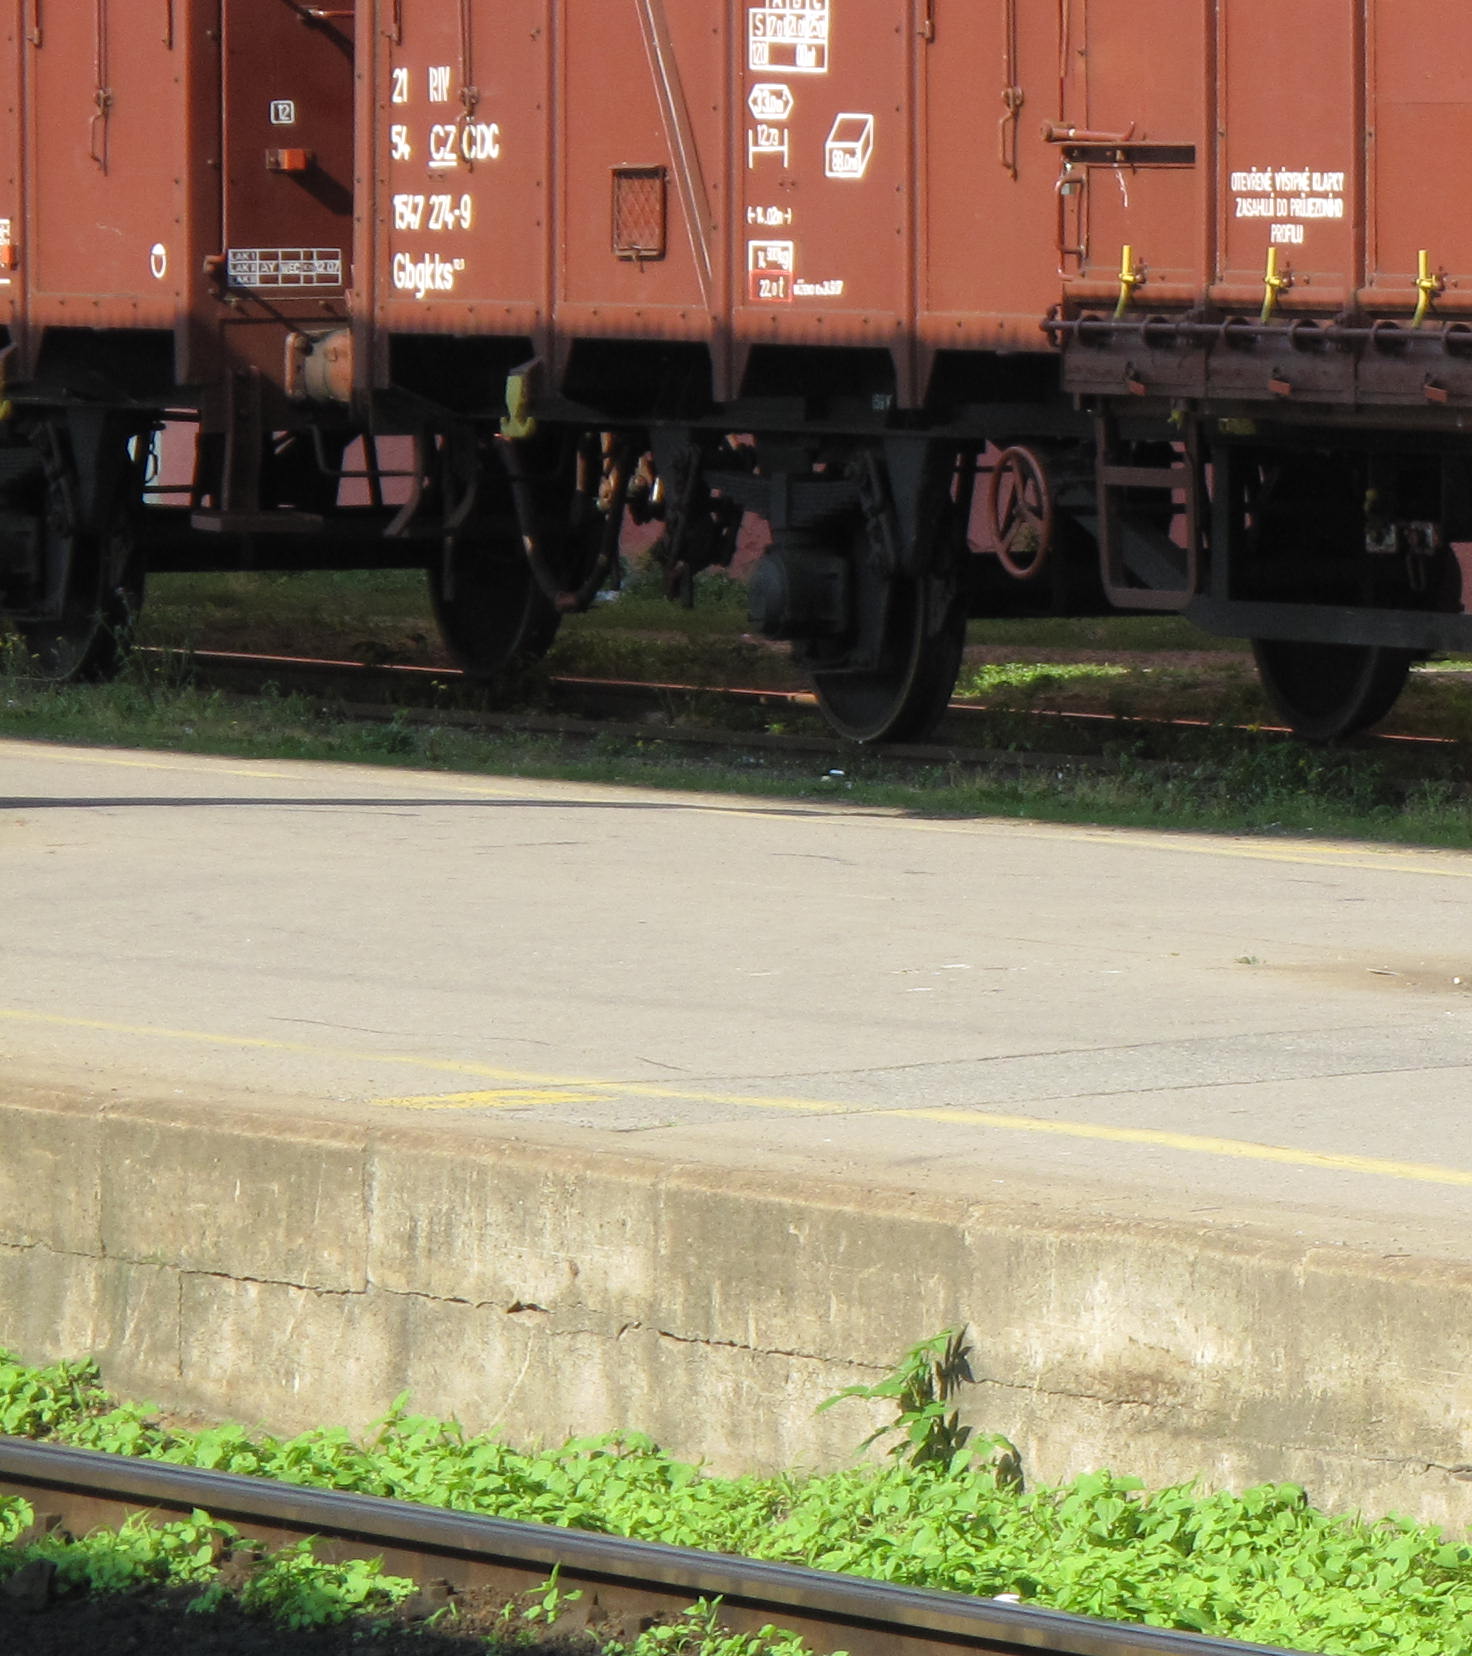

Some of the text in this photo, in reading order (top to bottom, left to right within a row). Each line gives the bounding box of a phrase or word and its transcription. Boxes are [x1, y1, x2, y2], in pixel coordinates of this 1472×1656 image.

[754, 13, 764, 36] S
[392, 66, 451, 103] 21 RIV
[278, 104, 291, 121] 12
[391, 124, 411, 161] 54
[429, 124, 457, 161] CZ
[393, 193, 472, 231] 1547 274-9
[393, 252, 455, 299] Gbgkks
